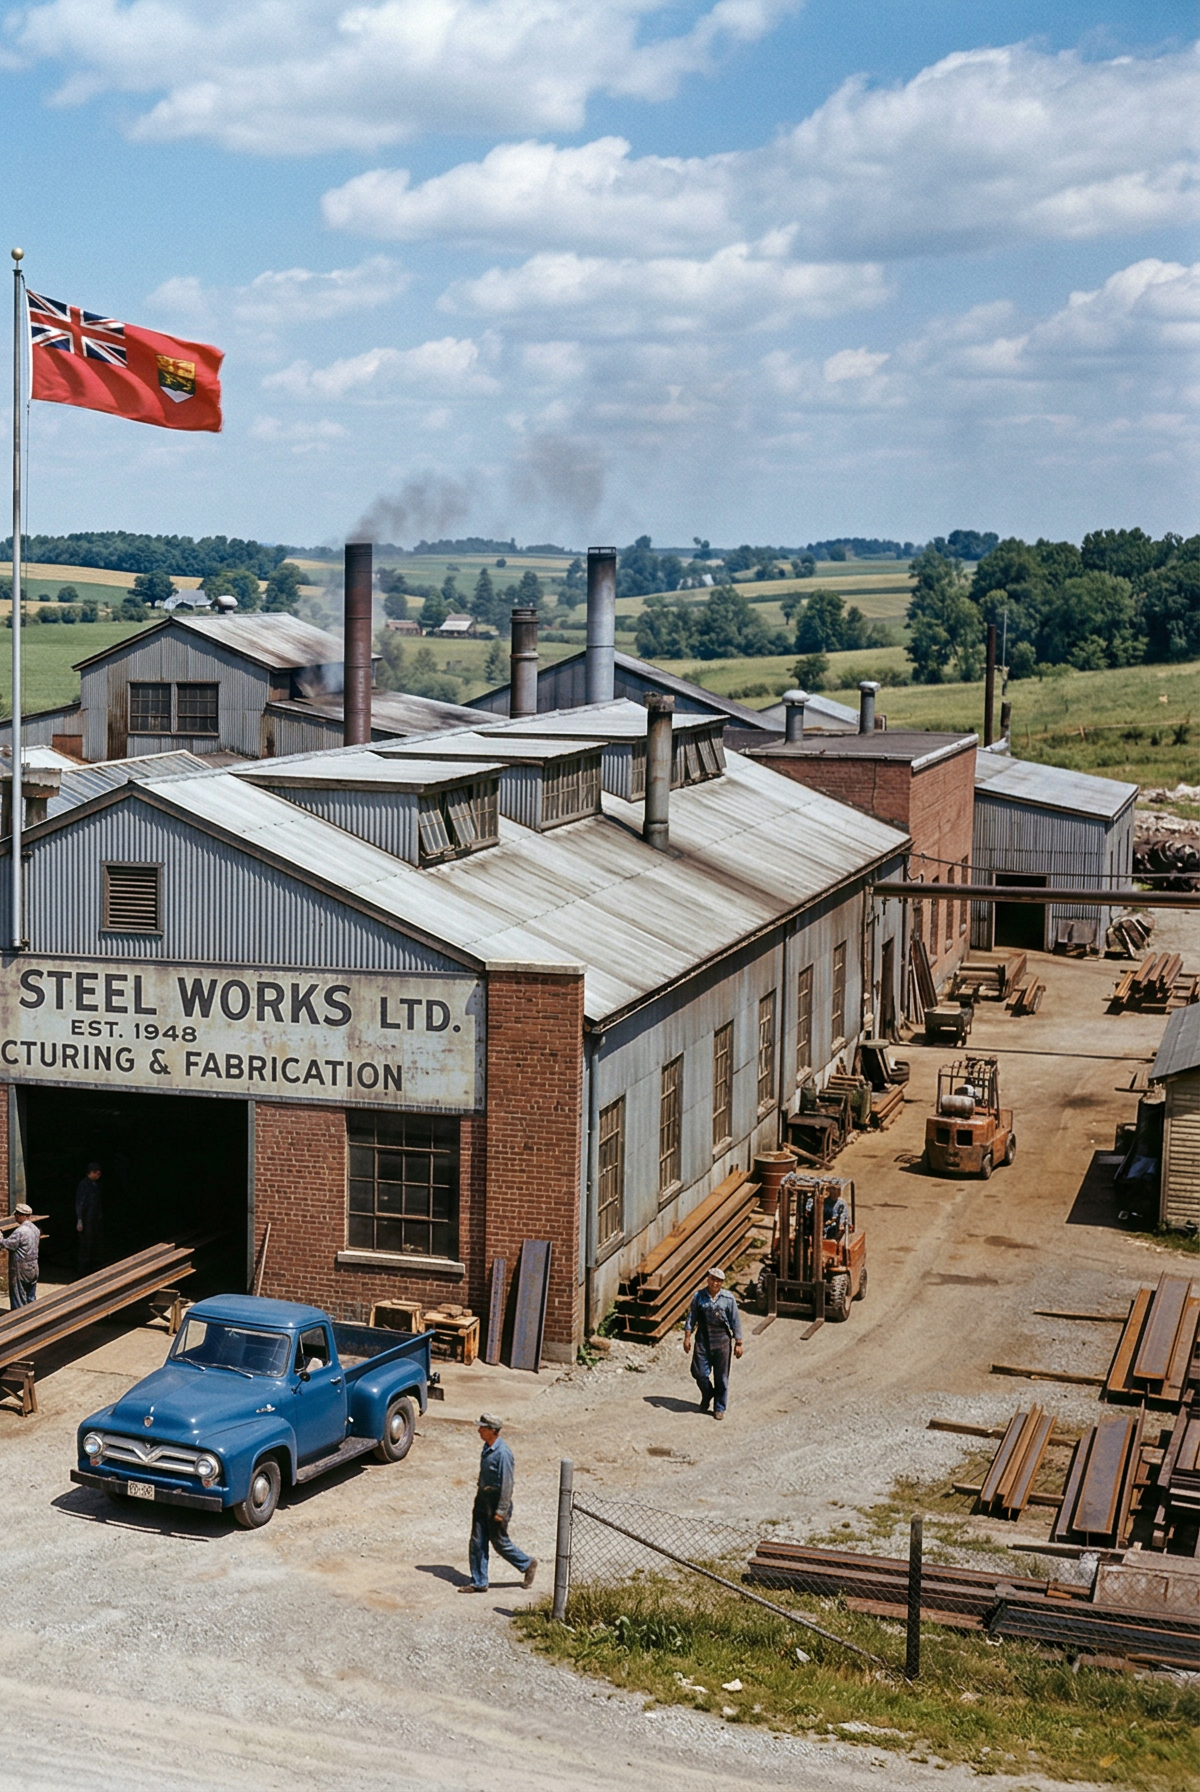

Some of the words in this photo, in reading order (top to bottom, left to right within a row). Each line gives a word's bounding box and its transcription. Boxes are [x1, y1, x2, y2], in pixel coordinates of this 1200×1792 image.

[19, 968, 158, 1016] STEEL
[178, 976, 352, 1027] WORKS
[380, 996, 461, 1033] LTD.
[71, 1019, 123, 1038] EST.
[134, 1022, 198, 1043] 1948
[149, 1048, 172, 1075] &
[185, 1050, 403, 1092] FABRICATION
